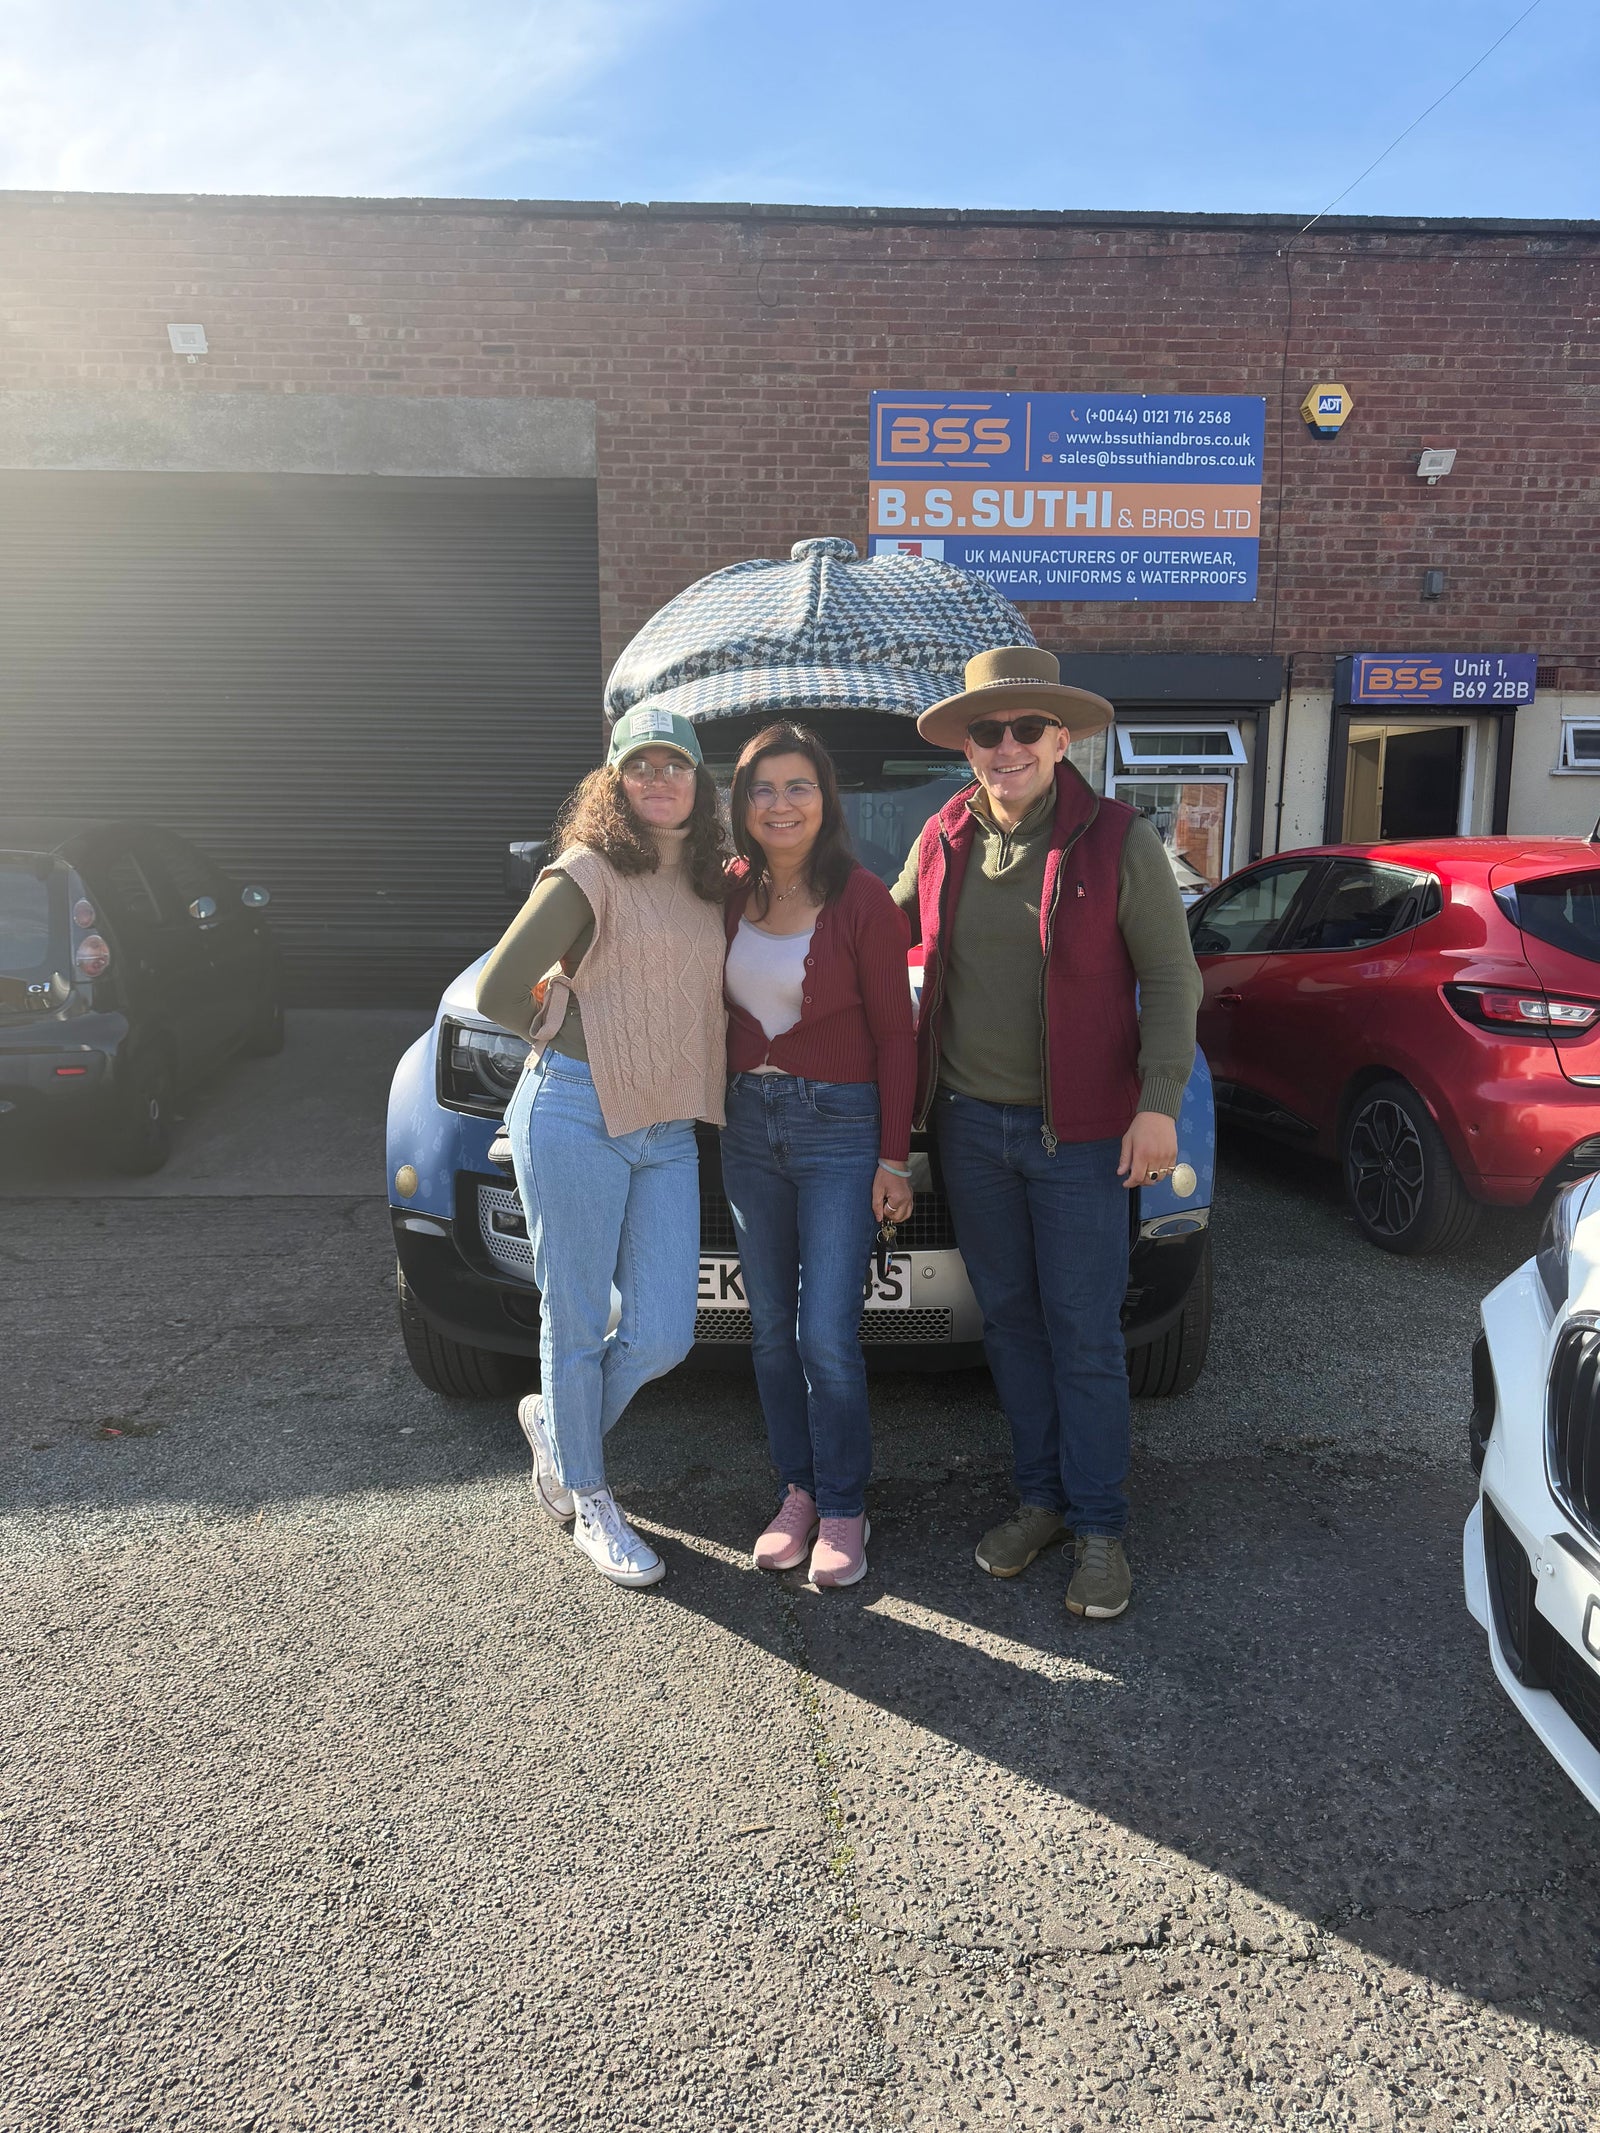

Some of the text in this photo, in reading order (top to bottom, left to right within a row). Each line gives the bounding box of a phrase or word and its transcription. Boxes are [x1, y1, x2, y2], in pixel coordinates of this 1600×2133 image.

[1318, 398, 1342, 411] ADT
[1085, 408, 1232, 425] (+0044) 0121 716 2568
[891, 417, 1011, 454] BSS
[1066, 431, 1251, 447] www.bssuthiandbros.co.uk
[1059, 451, 1256, 467] sales@bssuthiandbros.co.uk
[1117, 508, 1135, 529] &
[1142, 508, 1205, 529] BROS
[1214, 509, 1251, 530] LTD
[965, 549, 1237, 567] UK MANUFACTURERS OF OUTERWEAR,
[968, 569, 1248, 585] RKWEAR, UNIFORMS & WATERPROOFS
[1454, 658, 1508, 679] Unit 1,
[1368, 667, 1443, 690] BSS
[1452, 681, 1529, 699] B69 2BB
[697, 1263, 746, 1301] EK
